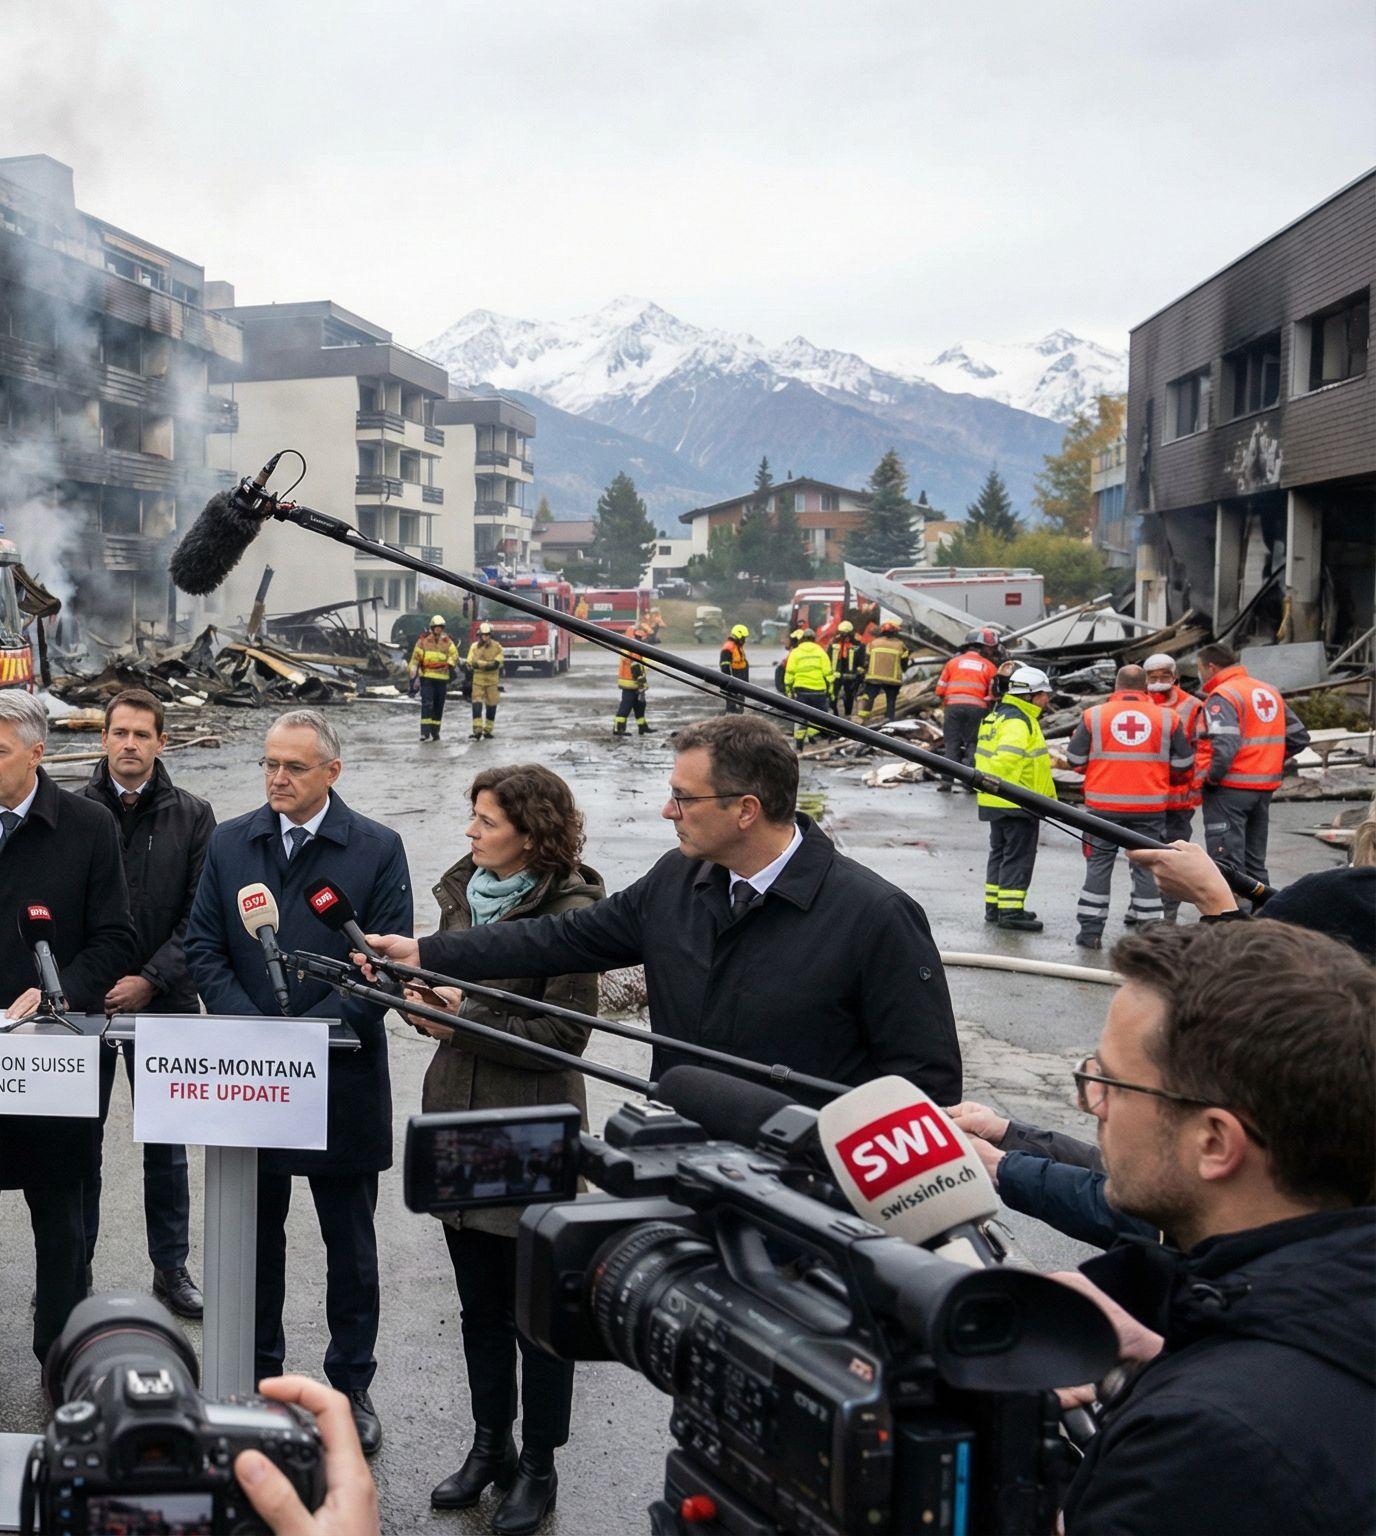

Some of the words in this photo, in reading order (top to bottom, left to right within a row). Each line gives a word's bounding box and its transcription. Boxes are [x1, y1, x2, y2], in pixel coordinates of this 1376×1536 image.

[31, 1057, 86, 1073] SUISSE
[145, 1056, 317, 1079] CRANS-MONTANA
[170, 1082, 210, 1100] FIRE
[217, 1084, 291, 1103] UPDATE
[851, 1115, 949, 1183] SWI
[880, 1165, 977, 1221] swissinfo.ch
